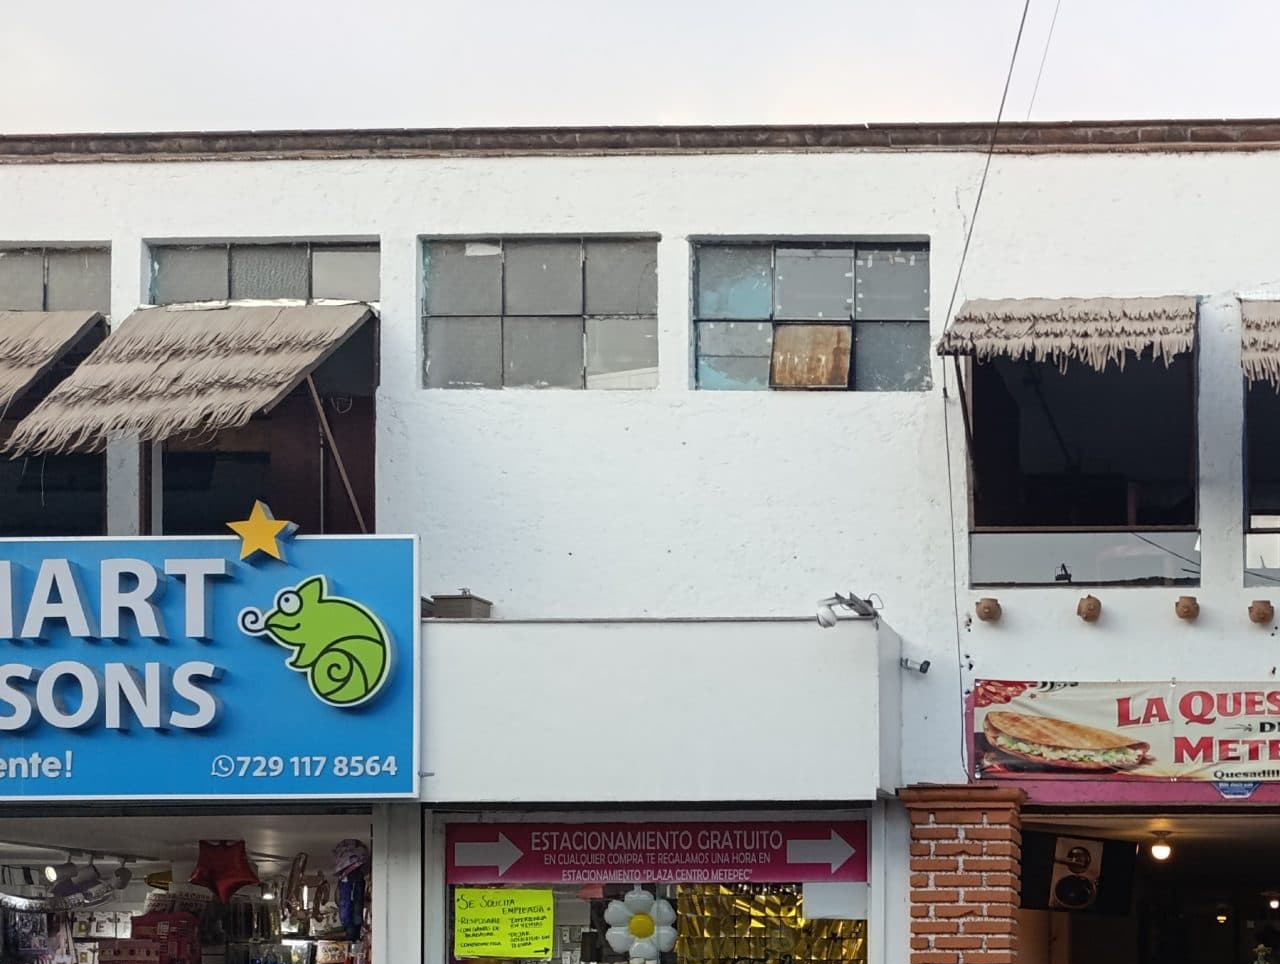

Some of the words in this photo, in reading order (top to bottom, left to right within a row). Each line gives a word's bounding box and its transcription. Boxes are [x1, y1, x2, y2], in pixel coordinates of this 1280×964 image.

[0, 558, 226, 638] ART
[1116, 695, 1169, 727] LA
[237, 756, 284, 777] 729
[290, 756, 329, 776] 117
[333, 755, 397, 776] 8564
[531, 831, 693, 851] ESTACIONAMIENTO
[697, 830, 783, 850] GRATUITO
[544, 854, 555, 864] EN
[558, 853, 606, 865] CUALQUIER
[607, 853, 644, 864] COMPRA
[646, 853, 656, 863] TE
[657, 852, 709, 864] REGALAMOS
[711, 852, 730, 863] UNA
[732, 852, 757, 863] HORA
[758, 852, 770, 863] EN
[561, 869, 641, 881] ESTACIONAMIENTO
[643, 869, 674, 880] "PLAZA
[675, 869, 710, 880] CENTRO
[711, 869, 753, 880] METEPEC"
[459, 894, 474, 909] SE
